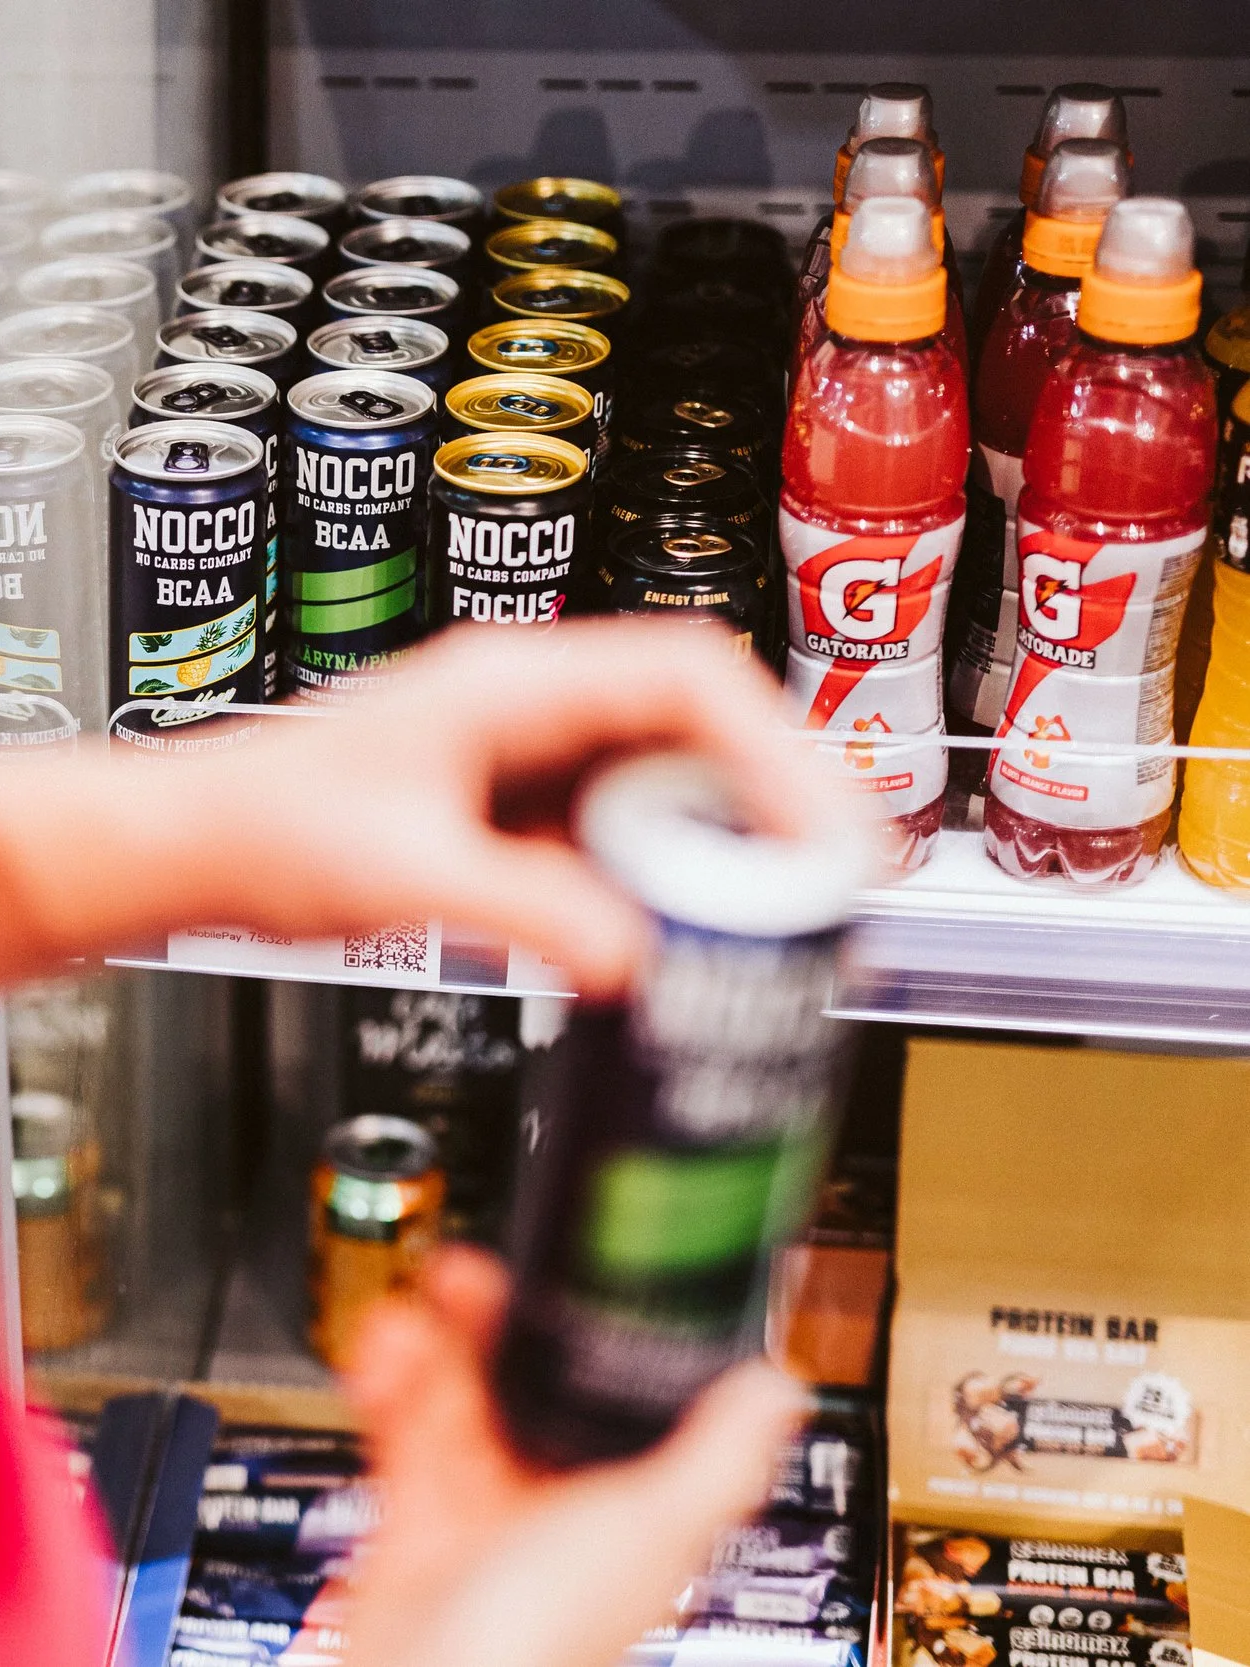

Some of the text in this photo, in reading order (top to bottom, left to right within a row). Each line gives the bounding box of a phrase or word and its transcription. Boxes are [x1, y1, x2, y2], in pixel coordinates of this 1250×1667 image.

[296, 446, 416, 499] NOCCO
[298, 493, 412, 515] NO CARBS COMPANY
[133, 500, 256, 554] NOCCO
[315, 520, 391, 551] BCAA
[448, 512, 575, 567] NOCCO
[136, 546, 253, 571] NO CARBS COMPANY
[449, 561, 570, 583] NO CARBS COMPANY
[156, 576, 235, 607] BCAA
[453, 586, 558, 624] FOCUS
[644, 591, 731, 606] ENERGY DRINK
[820, 558, 902, 640] G
[807, 634, 909, 661] GATORADE
[879, 776, 910, 789] FLAVOR
[187, 928, 242, 942] MobilePay
[990, 1306, 1159, 1343] PROTEIN BAR
